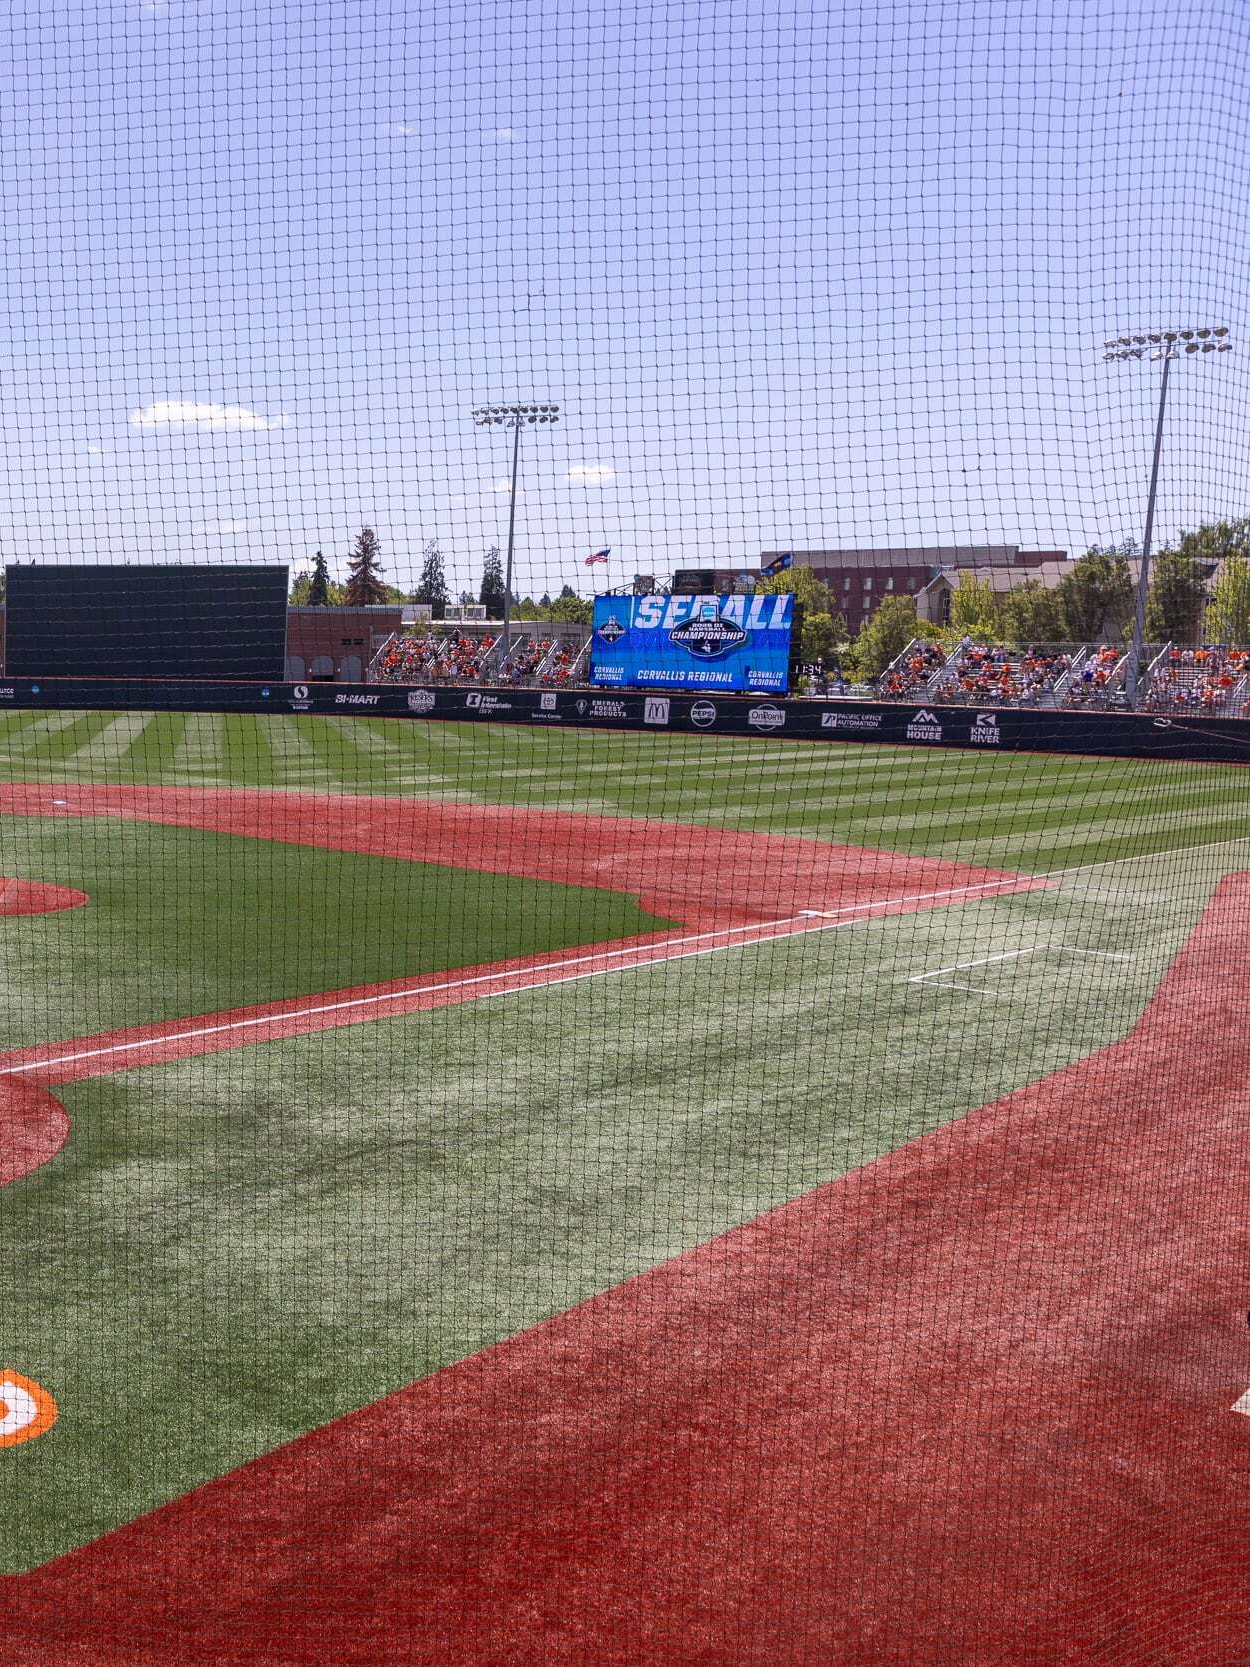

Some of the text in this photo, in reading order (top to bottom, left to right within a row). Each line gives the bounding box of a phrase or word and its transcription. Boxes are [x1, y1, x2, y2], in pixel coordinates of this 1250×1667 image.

[671, 631, 744, 640] CHAMPIONSHIP
[594, 666, 625, 674] CORVALLIS
[795, 664, 822, 674] 11:34
[594, 673, 623, 681] REGIONAL
[637, 670, 733, 683] CORVALLIS REGIONAL
[748, 671, 783, 679] CORVALLIS
[749, 678, 781, 687] REGIONAL
[692, 709, 715, 717] PEPSI
[751, 711, 783, 720] OnPoint
[837, 719, 879, 727] AUTOMATION
[907, 724, 942, 732] MOUNTAIN
[970, 727, 1000, 735] KNIFE
[906, 731, 942, 740] HOUSE
[970, 735, 1000, 743] RIVER
